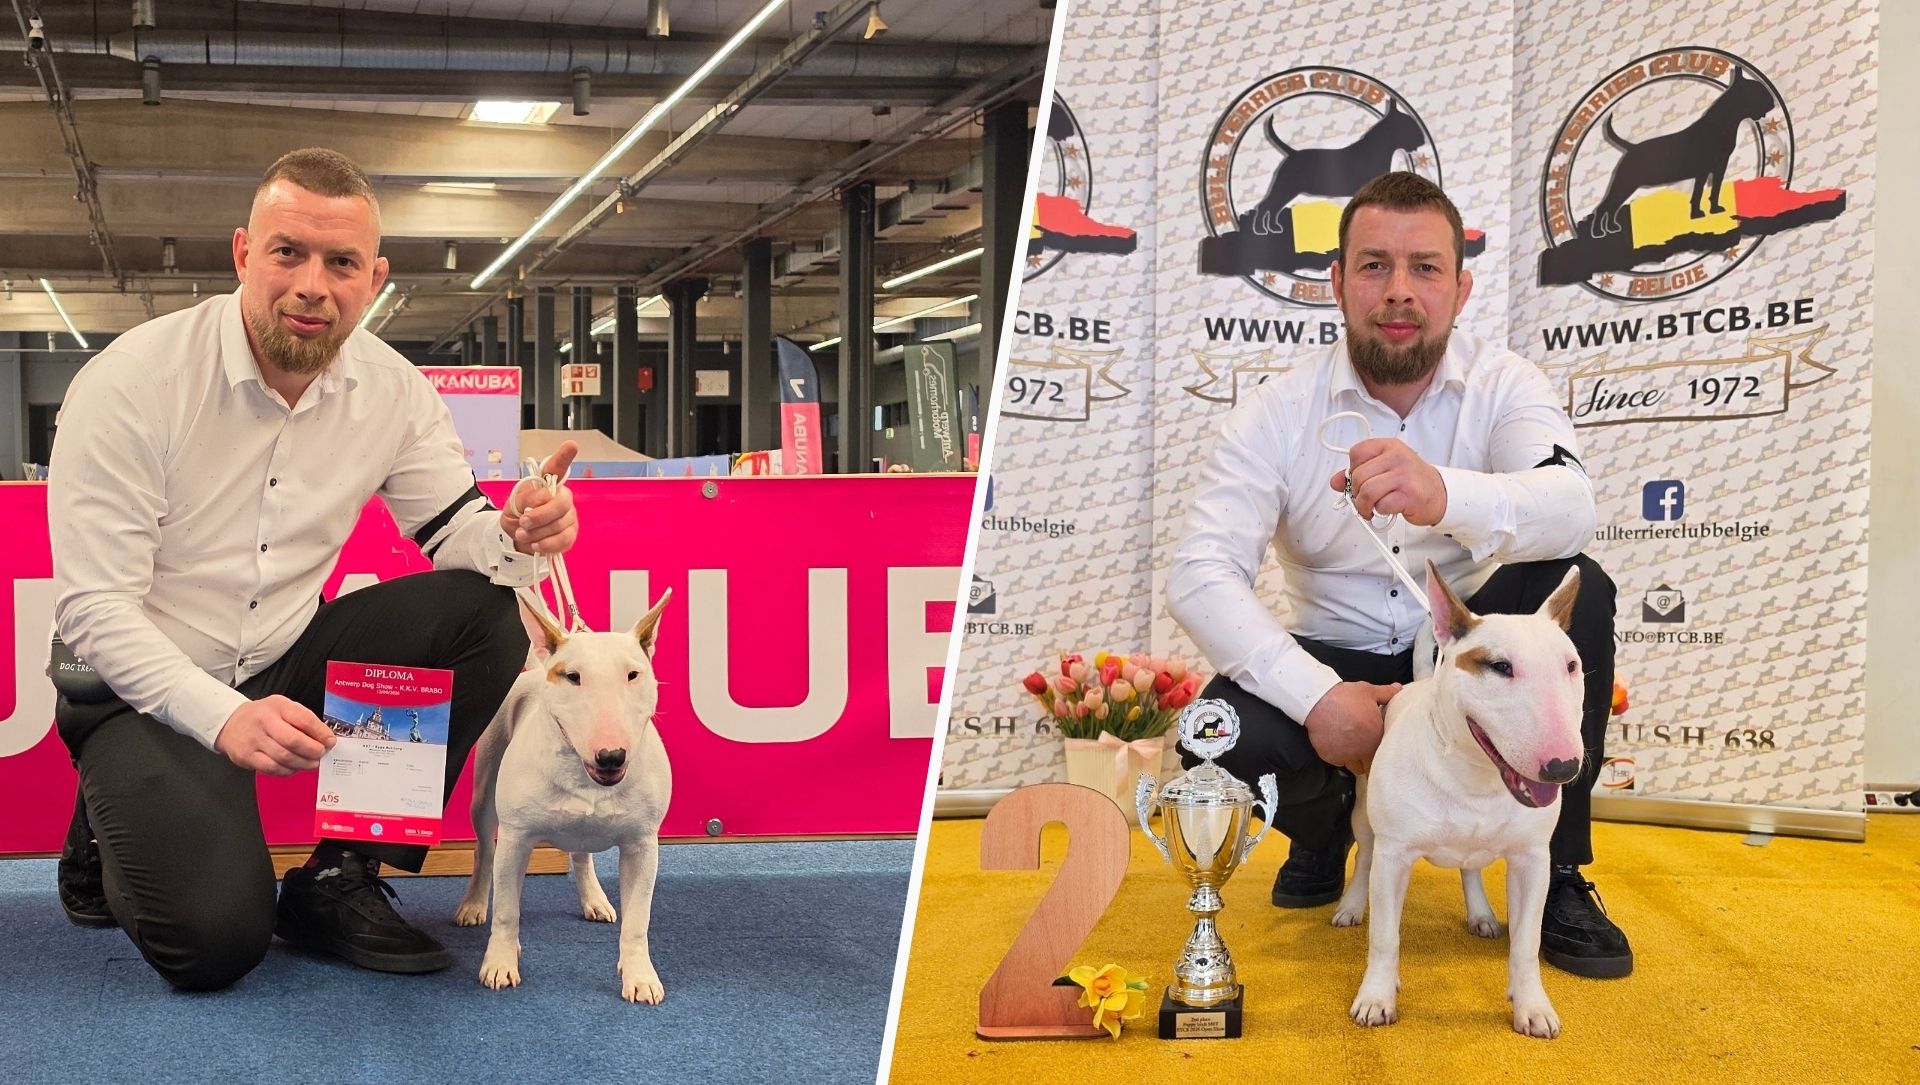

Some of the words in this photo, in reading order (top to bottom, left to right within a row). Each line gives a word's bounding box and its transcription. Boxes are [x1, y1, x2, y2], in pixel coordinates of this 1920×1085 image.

[1649, 53, 1730, 77] CLUB
[1310, 71, 1387, 105] CLUB
[1218, 73, 1307, 145] TERRIER
[1558, 65, 1648, 154] TERRIER
[1207, 154, 1233, 226] BULL
[1548, 163, 1569, 235] BULL
[1291, 281, 1334, 300] BEL
[1628, 263, 1709, 297] BELGIE
[1204, 317, 1346, 346] WWW.B
[1542, 298, 1814, 351] WWW.BTCB.BE
[1008, 376, 1065, 405] 972
[1574, 377, 1666, 418] Since
[1687, 376, 1761, 407] 1972
[981, 515, 1076, 539] clubbelgie
[1595, 521, 1770, 542] ullterrierclubbelgie
[1614, 631, 1724, 645] NFO@BTCB.BE
[60, 662, 75, 671] DOG
[365, 668, 414, 681] DIPLOMA
[335, 680, 360, 688] Antwerp
[421, 686, 443, 694] BRABO
[1724, 728, 1776, 751] 638
[980, 783, 1131, 1028] 2
